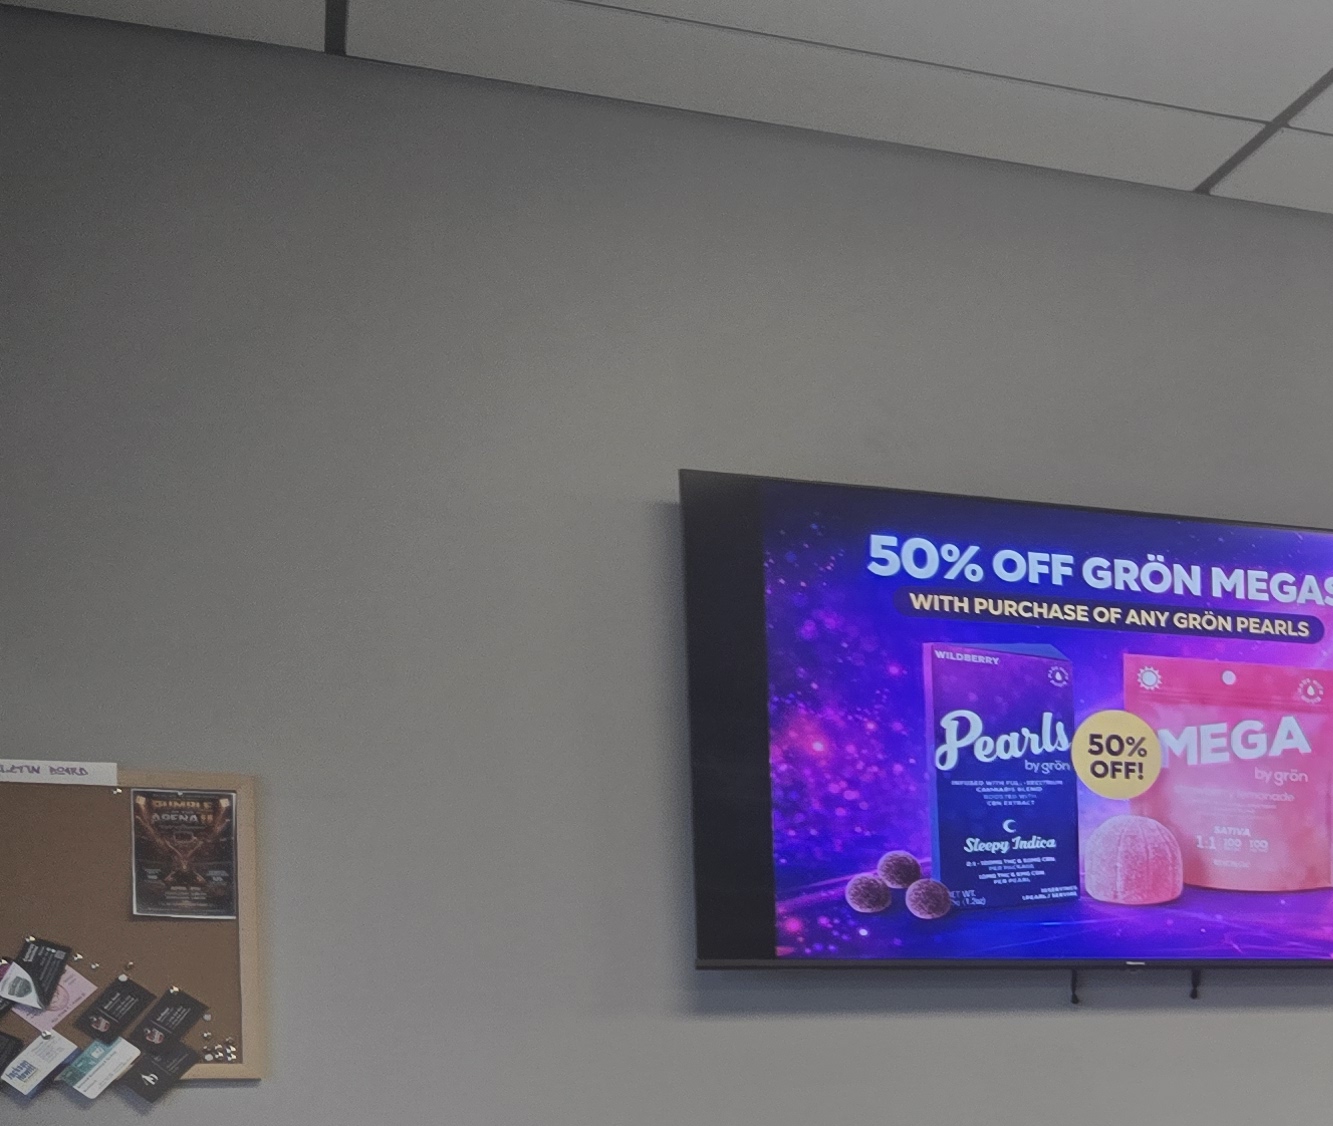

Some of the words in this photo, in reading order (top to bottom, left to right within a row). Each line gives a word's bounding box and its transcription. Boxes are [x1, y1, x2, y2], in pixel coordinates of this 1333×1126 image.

[867, 534, 984, 583] 50%
[992, 549, 1075, 587] OFF
[1083, 553, 1201, 598] GRÖN
[910, 592, 969, 614] WITH
[974, 597, 1089, 623] PURCHASE
[1093, 606, 1121, 624] OF
[1125, 609, 1169, 628] ANY
[1173, 610, 1233, 632] GRÖN
[1236, 618, 1310, 638] PEARLS
[934, 650, 1000, 665] WILDBERRY
[935, 709, 1071, 771] Pearls
[1087, 733, 1147, 758] 50%
[1157, 715, 1312, 769] MEGA
[1024, 759, 1039, 774] by
[1041, 760, 1071, 775] grön
[1089, 761, 1144, 780] OFF!
[1254, 767, 1271, 783] by
[1273, 769, 1309, 786] grön
[1213, 826, 1251, 837] SATIVA
[964, 837, 1010, 854] Sleepy
[1012, 835, 1057, 850] Indica
